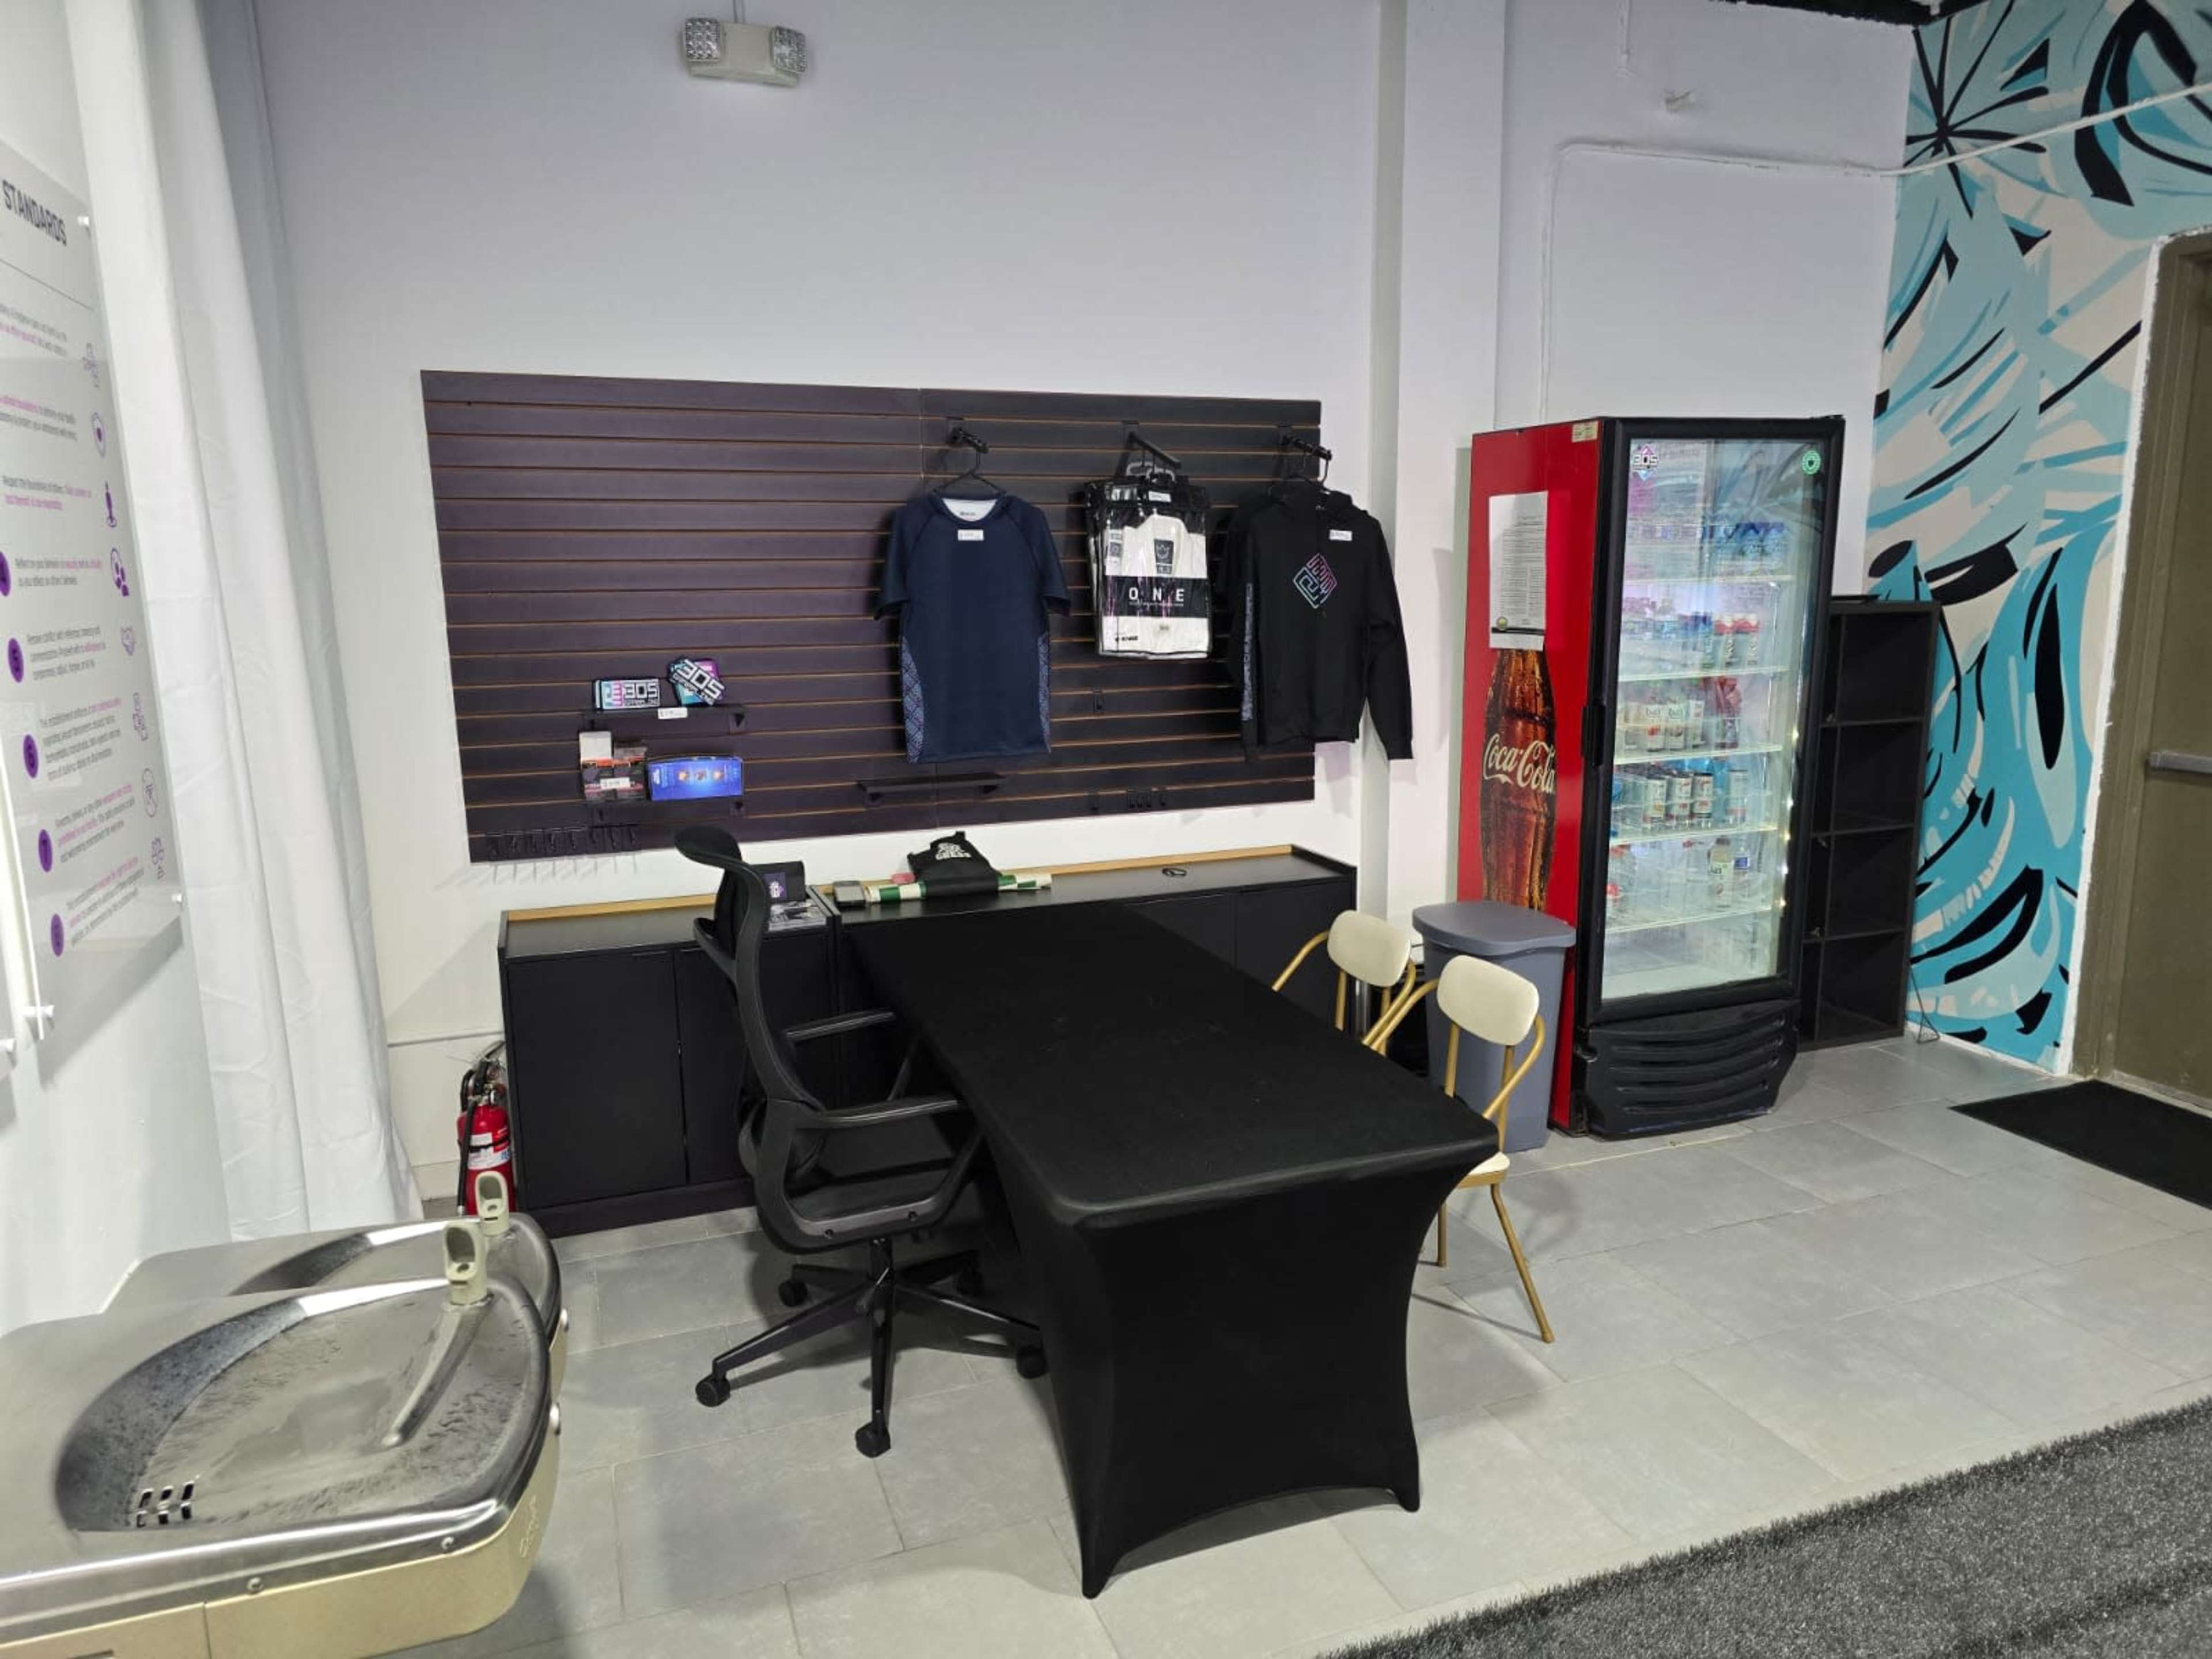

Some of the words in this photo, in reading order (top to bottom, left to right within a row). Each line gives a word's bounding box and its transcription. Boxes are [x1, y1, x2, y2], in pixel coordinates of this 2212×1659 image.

[2, 180, 67, 247] STANDARDS
[1129, 587, 1184, 602] ONE
[624, 683, 658, 699] 305
[677, 658, 725, 699] 305
[1483, 733, 1556, 794] Coca-Cola
